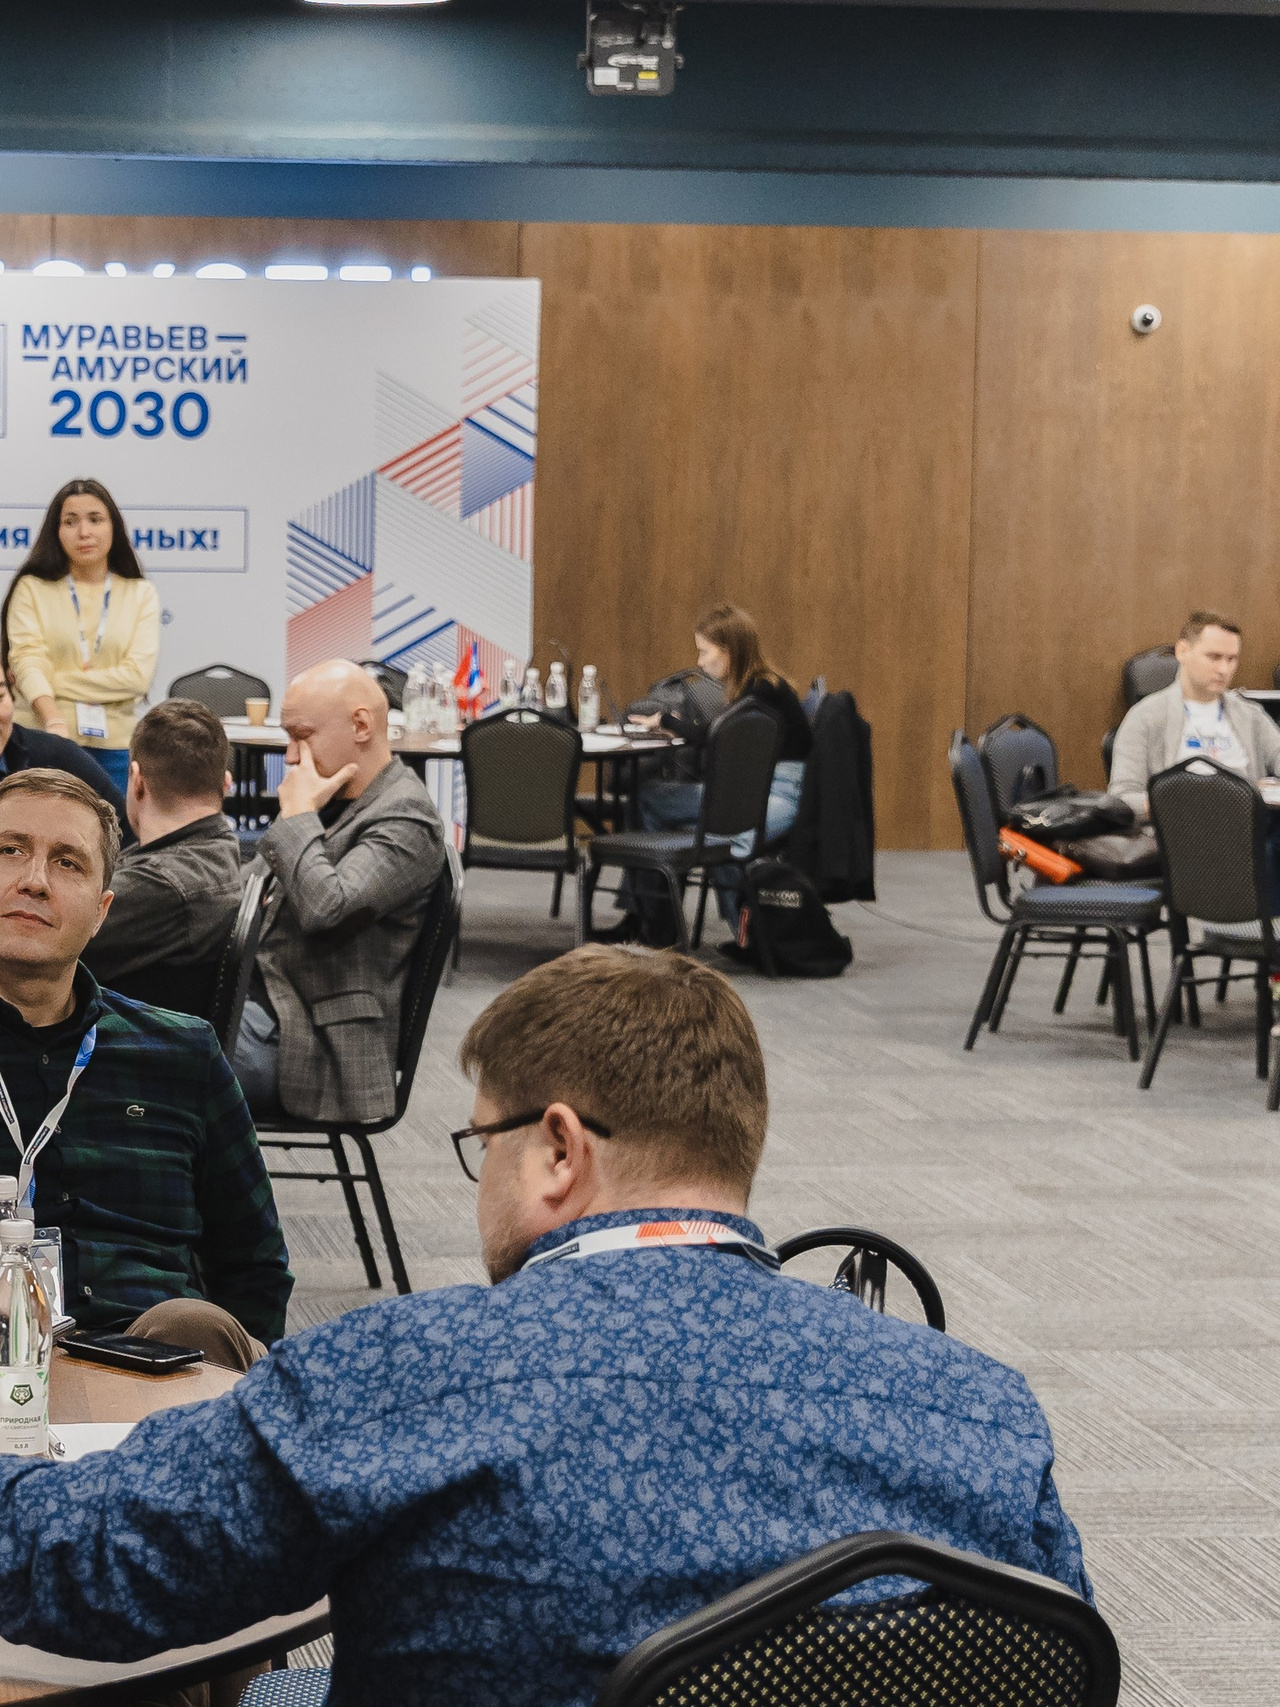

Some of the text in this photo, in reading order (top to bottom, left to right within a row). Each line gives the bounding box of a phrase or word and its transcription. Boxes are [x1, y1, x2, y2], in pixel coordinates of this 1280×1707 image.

[50, 389, 210, 438] 2030
[134, 529, 219, 550] НЫХ!
[0, 1415, 41, 1424] ПРИРОДНАЯ
